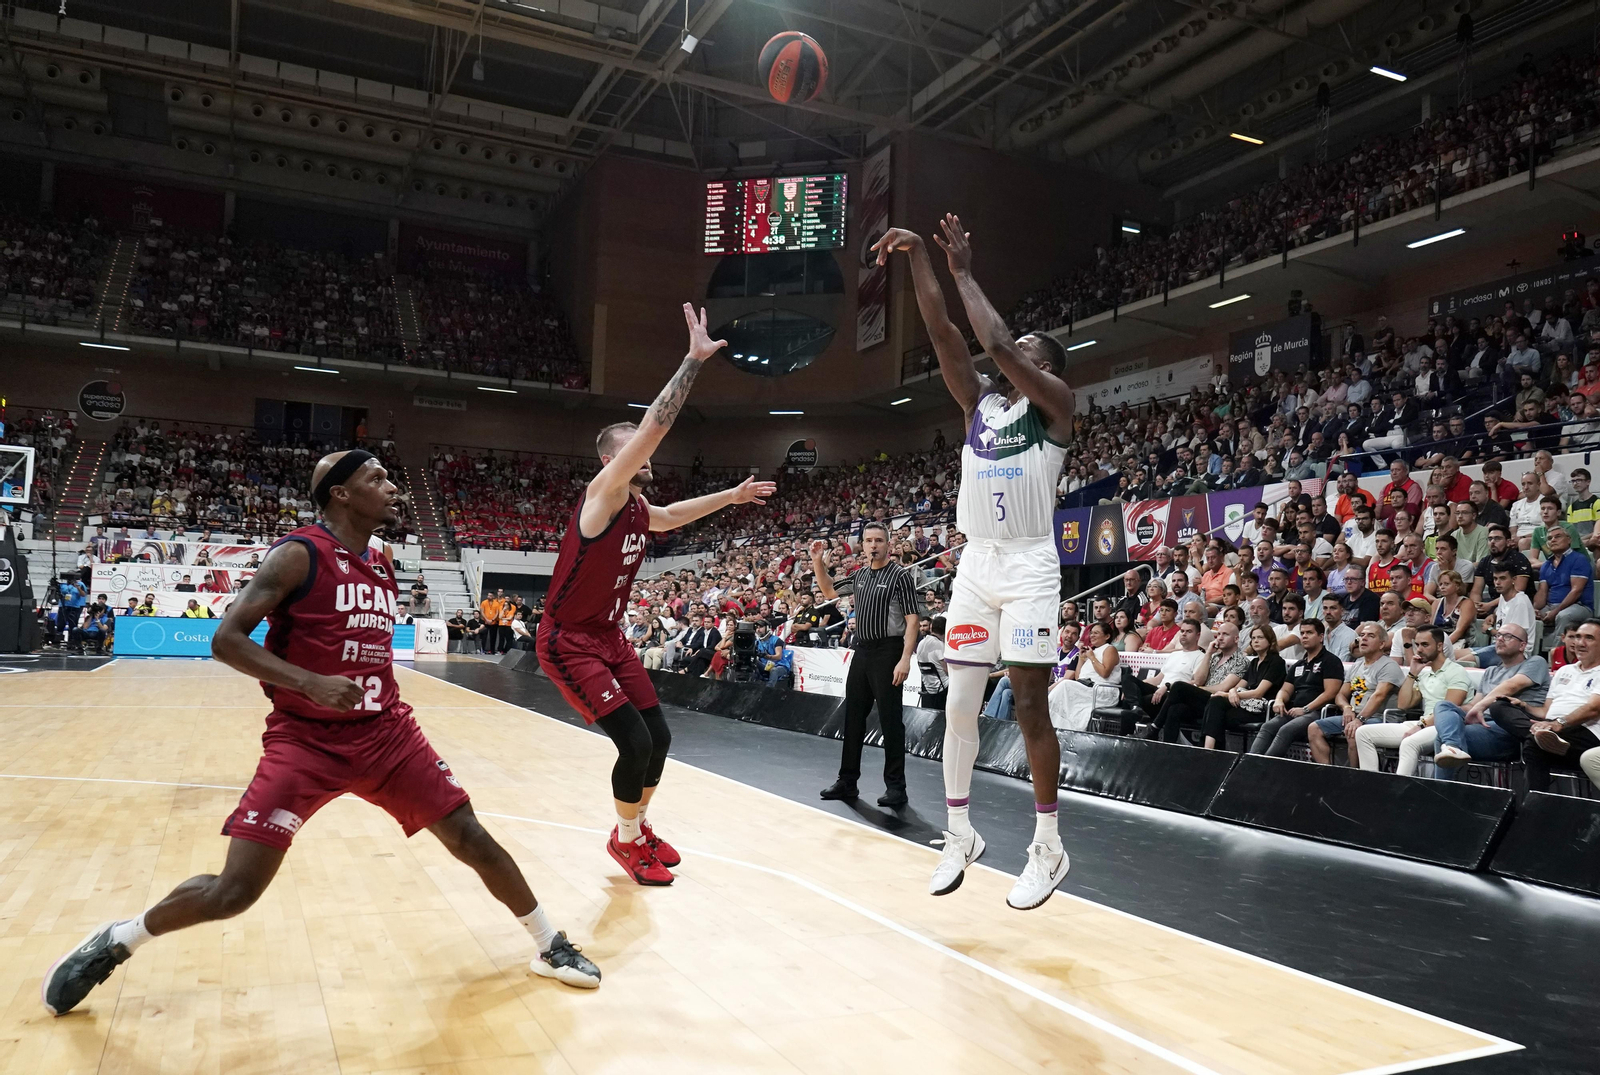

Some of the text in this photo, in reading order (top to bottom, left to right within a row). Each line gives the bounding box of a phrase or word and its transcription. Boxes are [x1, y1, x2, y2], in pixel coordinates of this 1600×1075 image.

[756, 203, 766, 214] 31
[784, 201, 795, 212] 31
[762, 235, 786, 245] 4:38
[416, 235, 510, 261] Ayuntamiento
[1533, 277, 1552, 289] IONOS
[1463, 293, 1493, 306] endesa
[1230, 337, 1309, 364] Región de Murcia
[83, 393, 121, 402] supercopa
[86, 399, 121, 409] endesa
[993, 432, 1027, 446] Unicaja
[977, 464, 1024, 480] málaga
[992, 491, 1006, 522] 3
[345, 613, 394, 635] MURCIA
[174, 632, 210, 643] Costa
